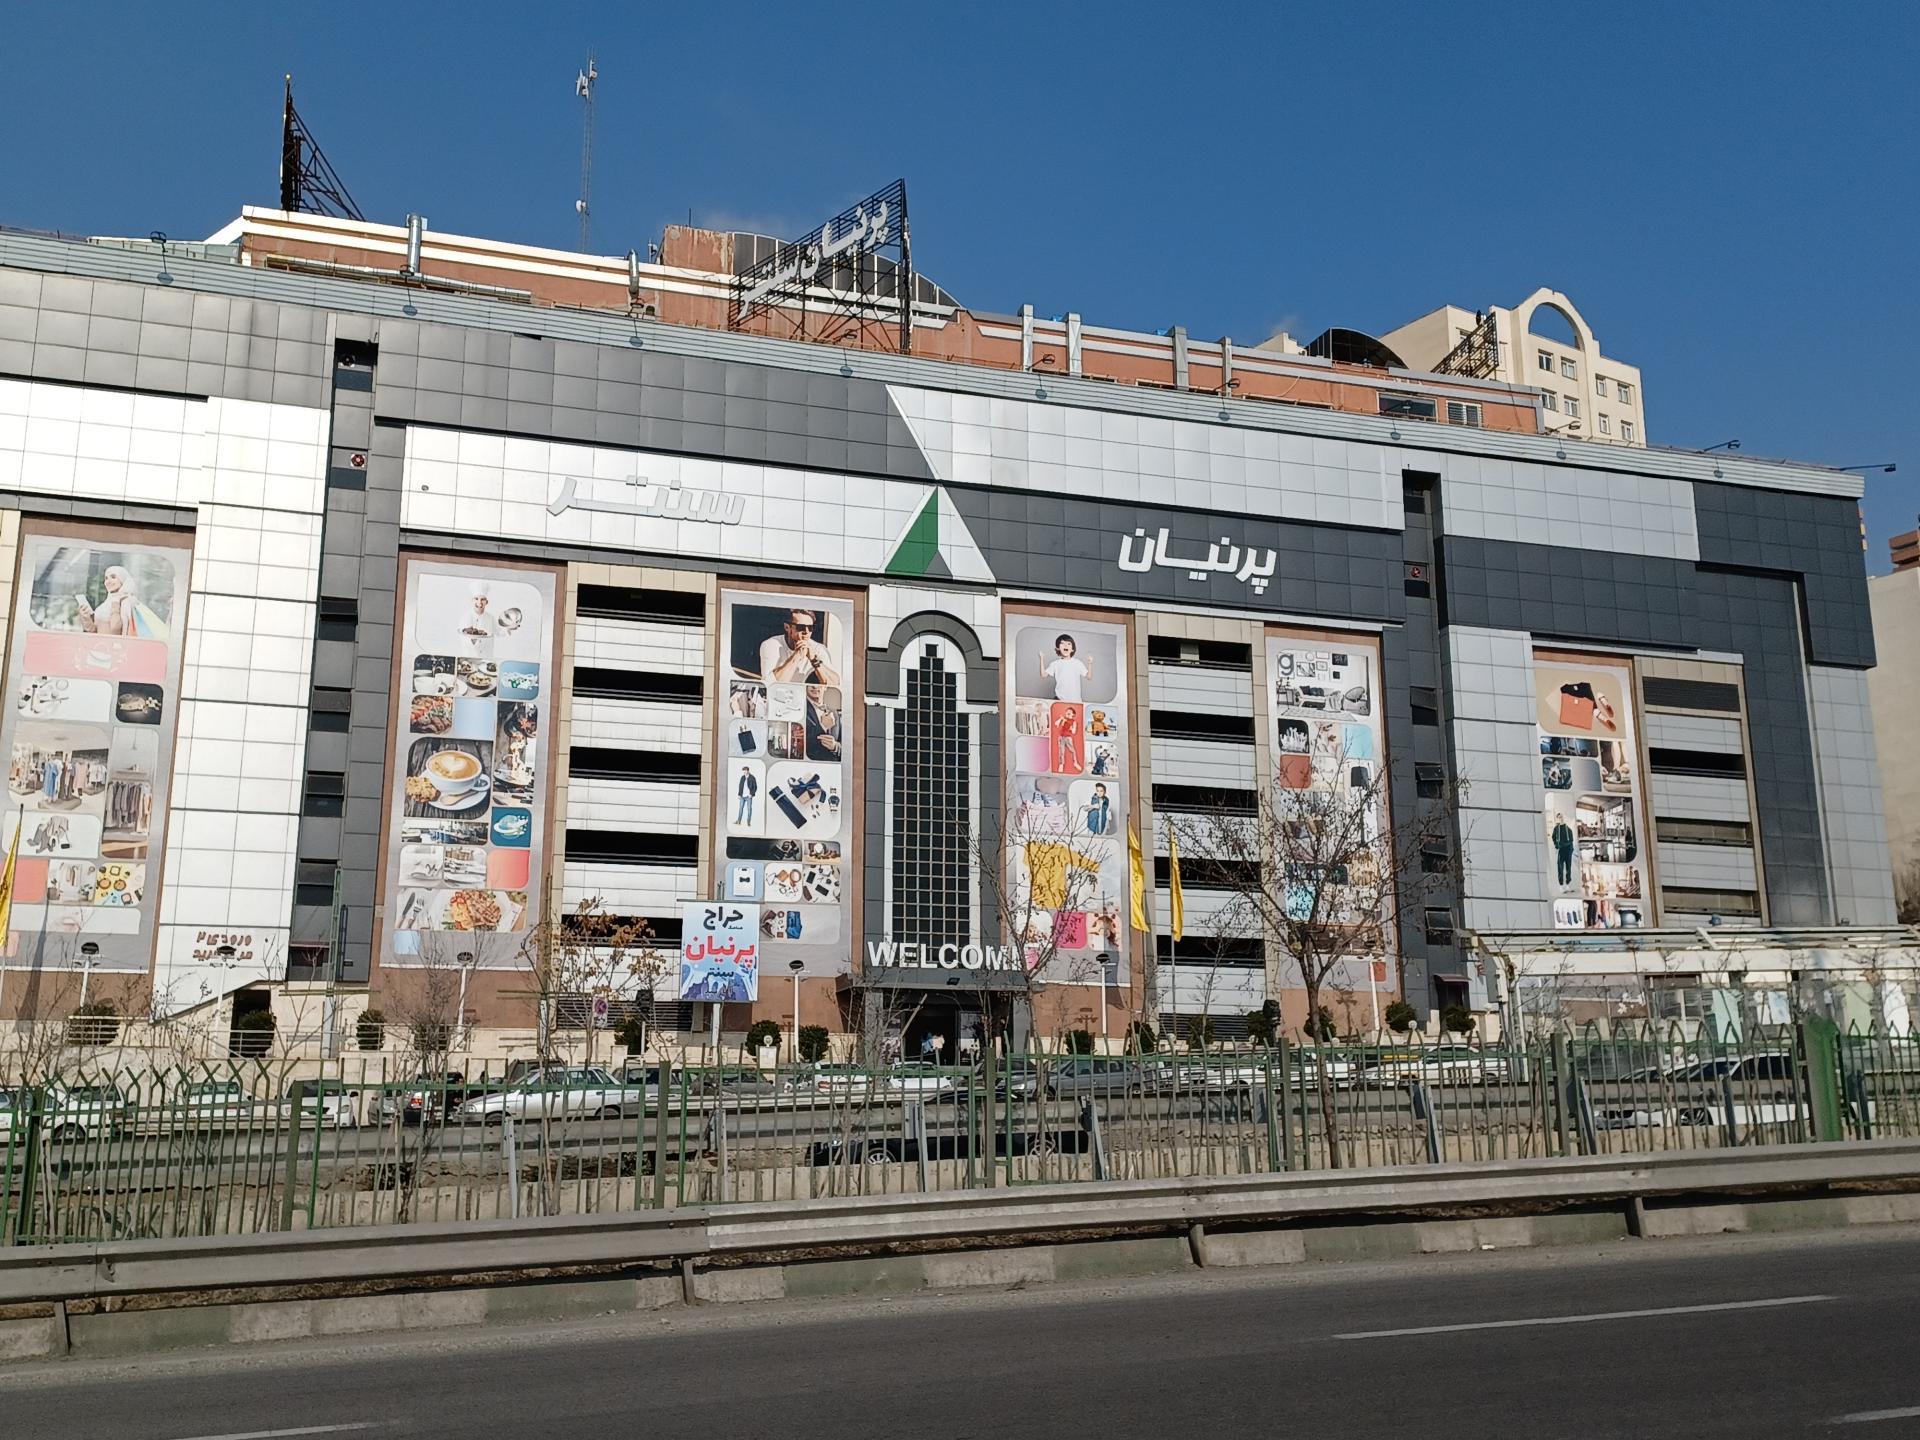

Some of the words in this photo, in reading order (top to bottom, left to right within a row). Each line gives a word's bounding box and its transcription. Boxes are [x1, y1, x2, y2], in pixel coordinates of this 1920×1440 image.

[800, 200, 889, 279] پرنیان
[736, 255, 799, 321] سنتر
[546, 474, 746, 526] سنتر
[1118, 527, 1277, 595] پرنیان
[703, 906, 744, 930] حراج
[685, 935, 755, 968] پرنیان
